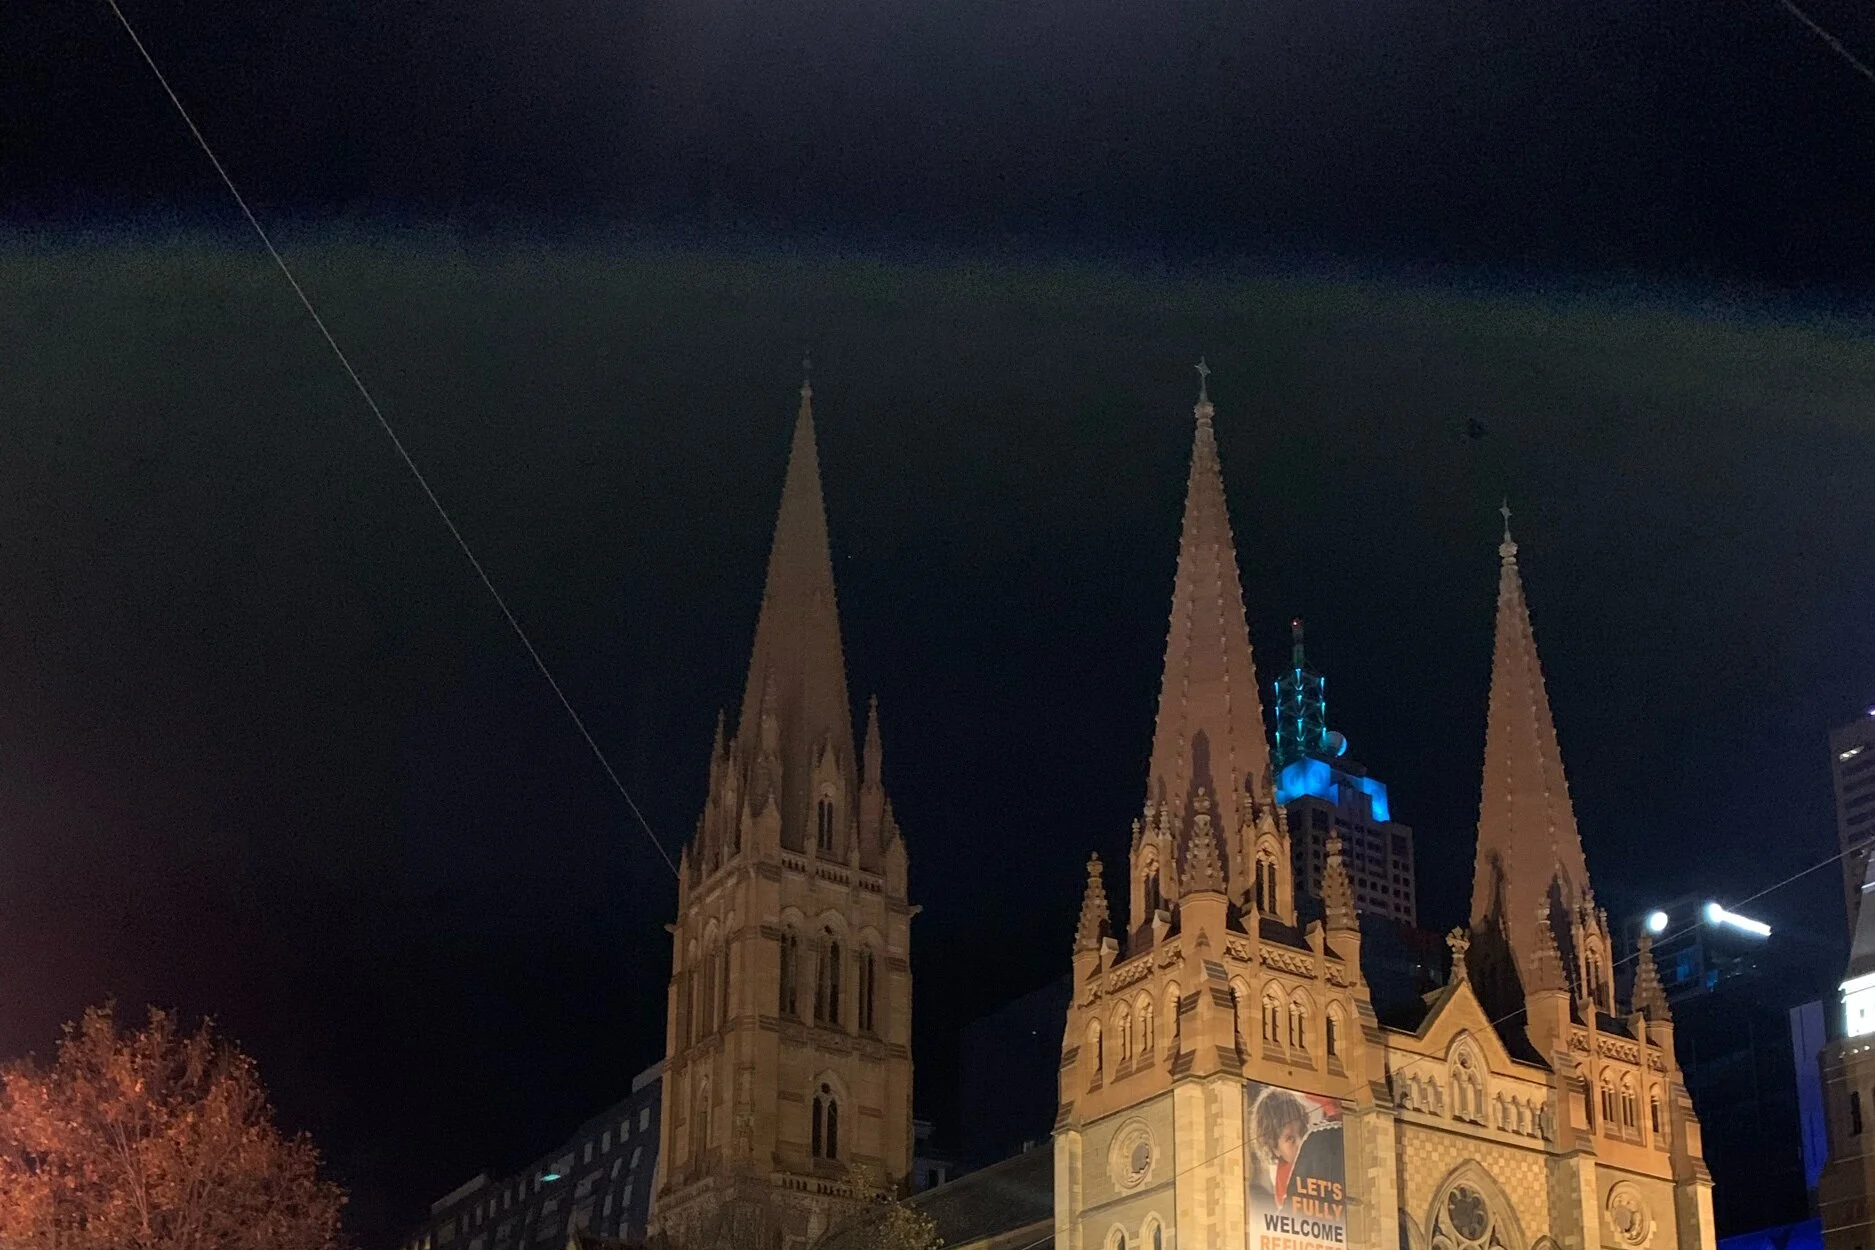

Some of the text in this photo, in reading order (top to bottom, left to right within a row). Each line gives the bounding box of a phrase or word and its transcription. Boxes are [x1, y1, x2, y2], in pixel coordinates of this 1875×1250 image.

[1296, 1176, 1343, 1200] LET'S
[1292, 1196, 1343, 1221] FULLY
[1264, 1213, 1344, 1243] WELCOME
